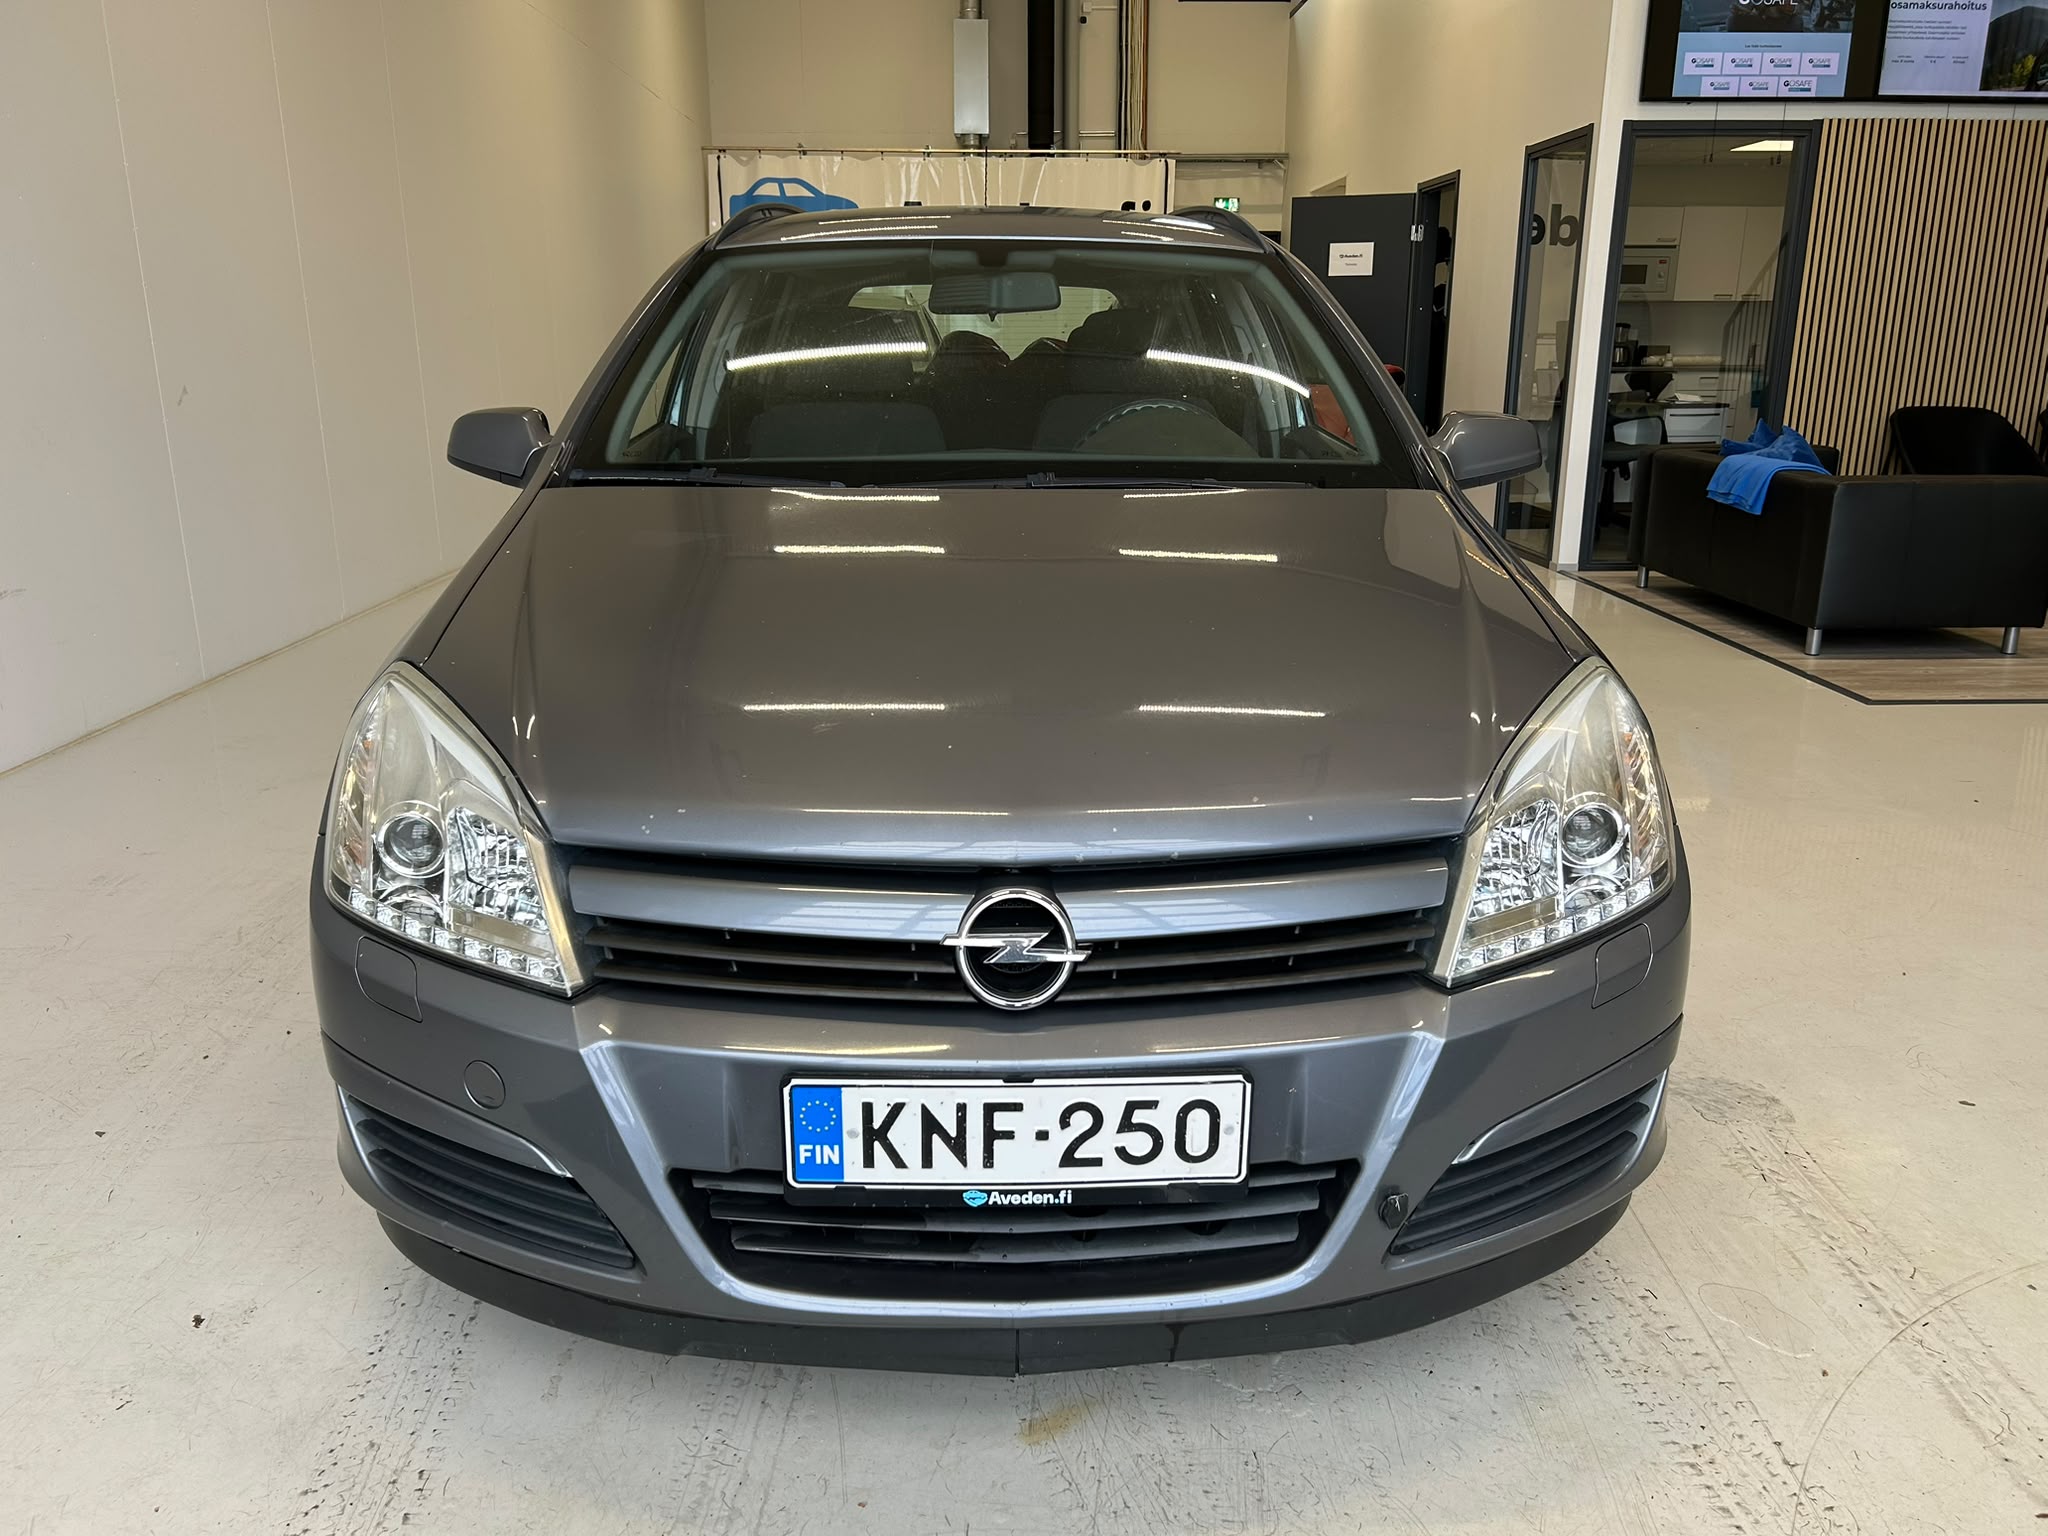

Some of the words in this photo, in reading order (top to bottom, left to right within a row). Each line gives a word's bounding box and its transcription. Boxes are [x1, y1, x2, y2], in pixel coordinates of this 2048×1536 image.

[1890, 0, 1987, 11] osamaksurahoitus
[861, 1099, 1221, 1168] KNF-250
[799, 1144, 840, 1165] FIN
[988, 1189, 1072, 1205] Aveden.fi
